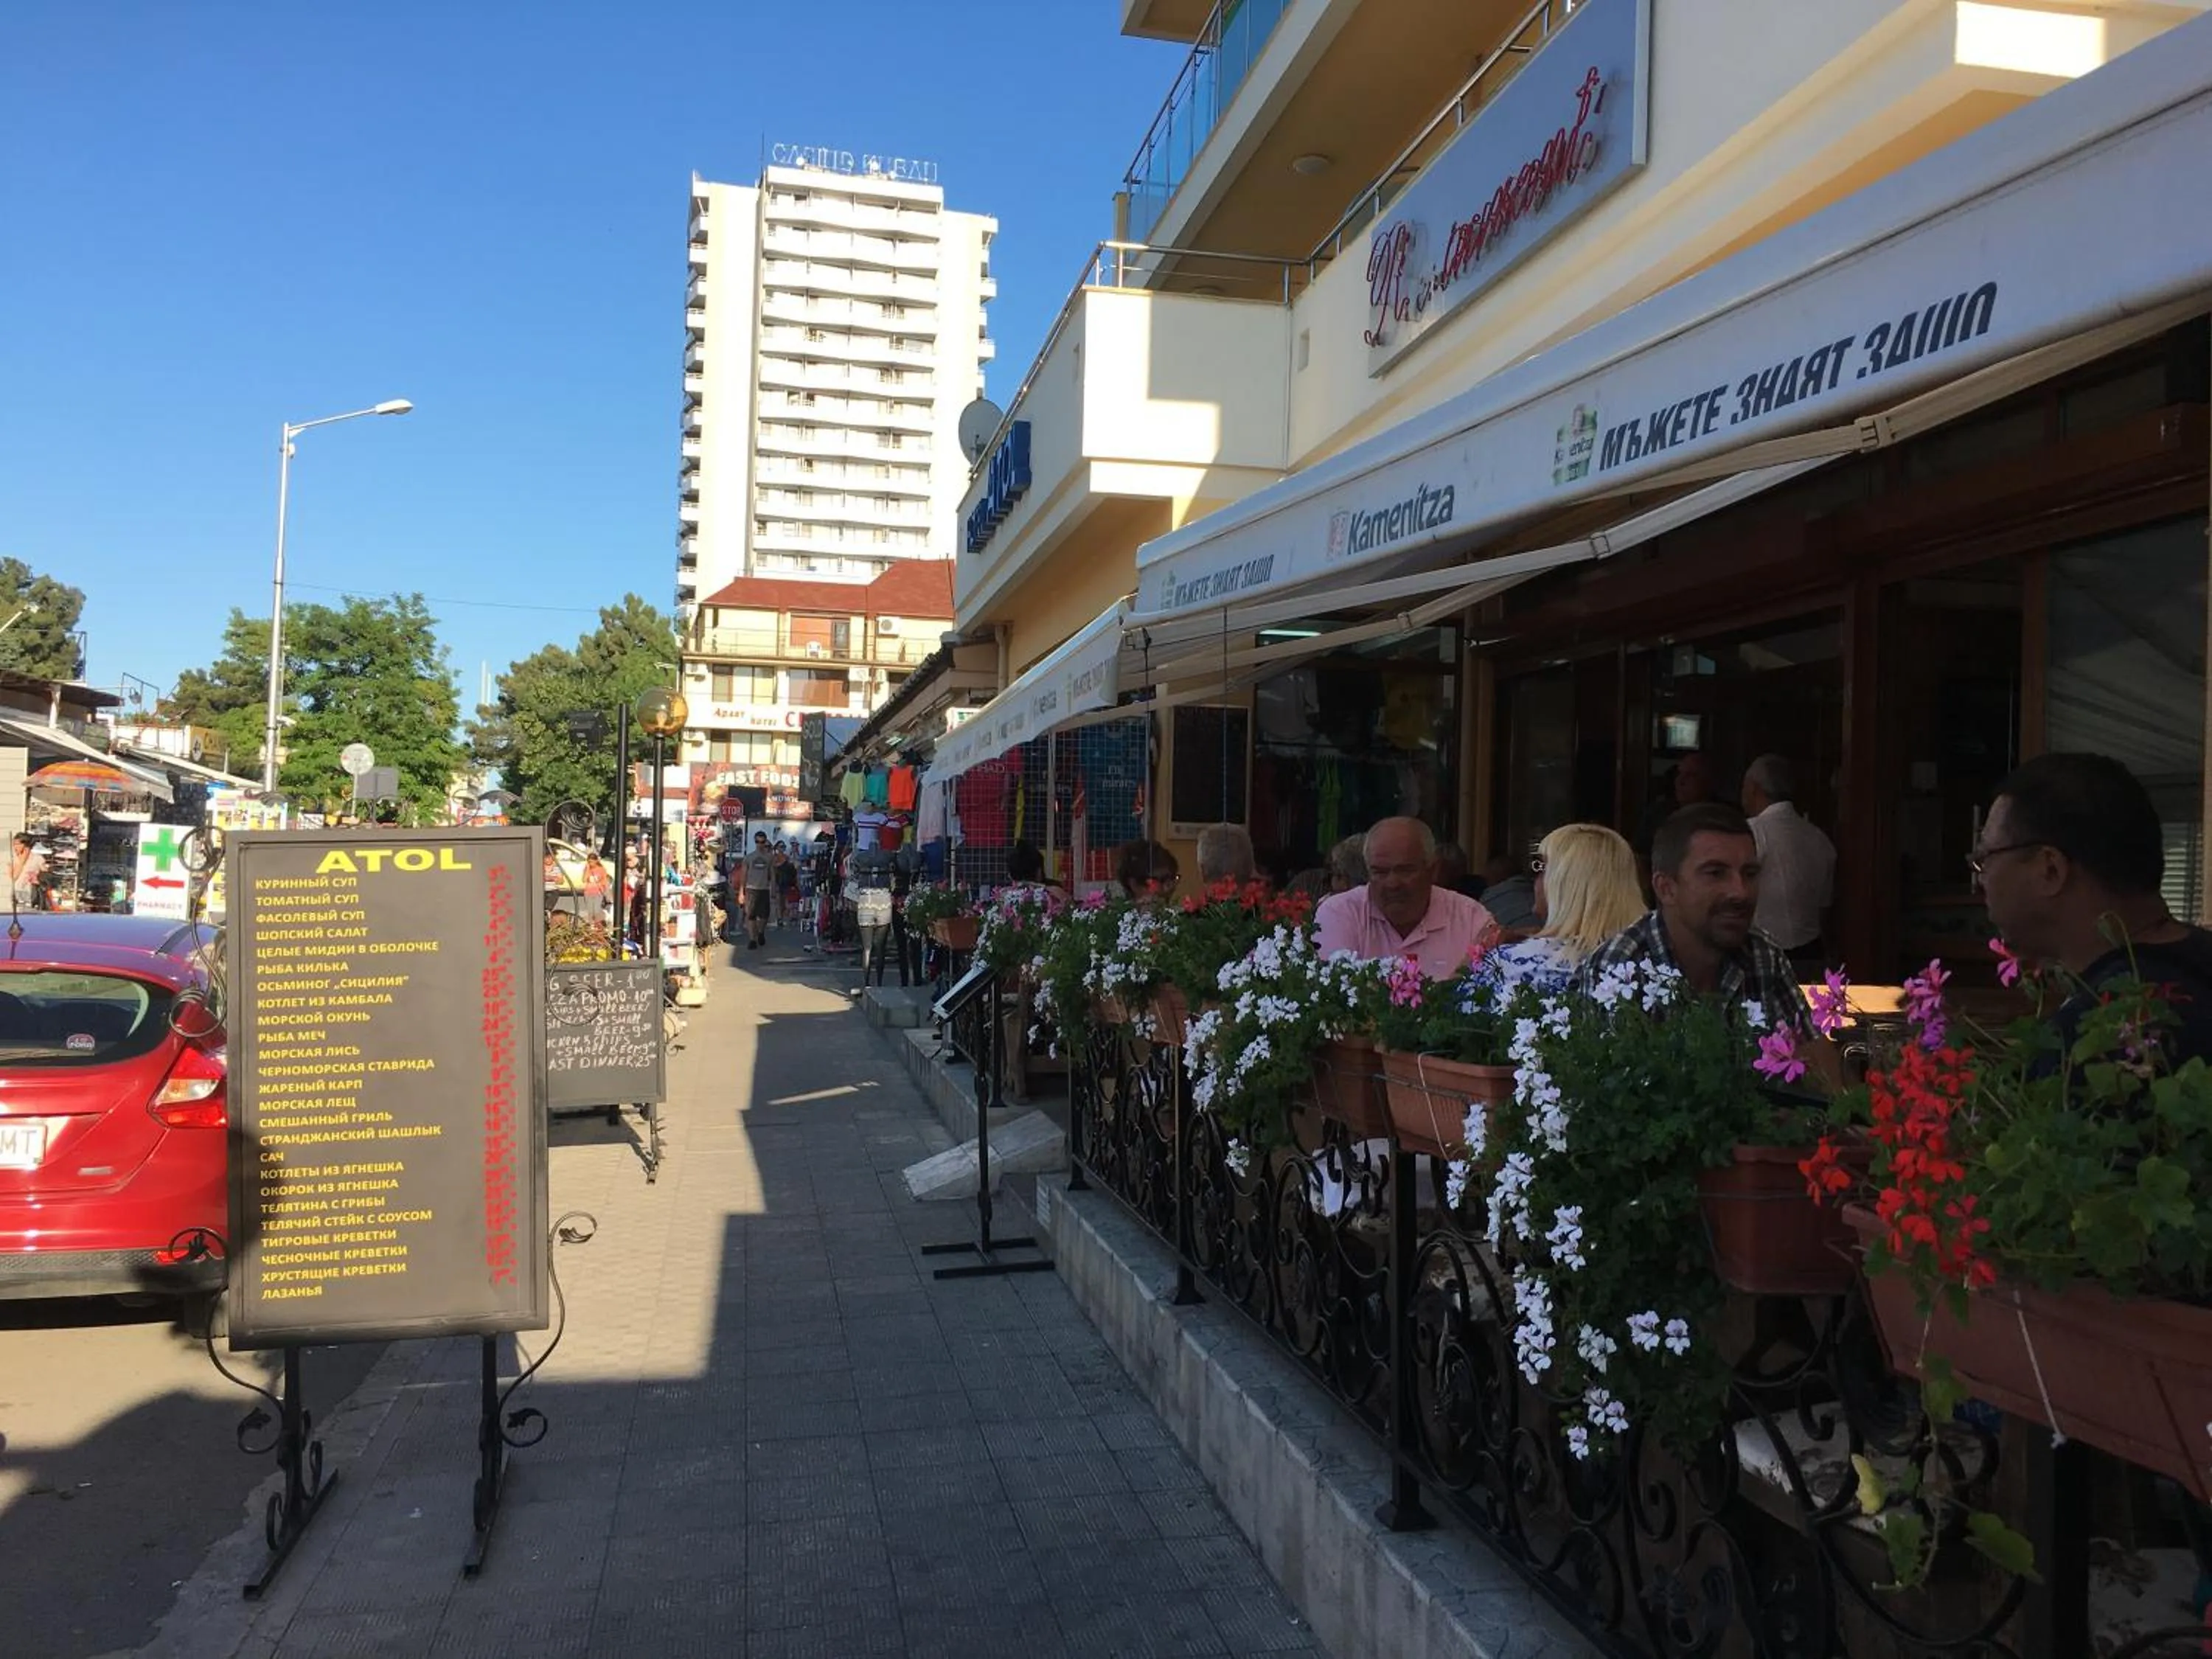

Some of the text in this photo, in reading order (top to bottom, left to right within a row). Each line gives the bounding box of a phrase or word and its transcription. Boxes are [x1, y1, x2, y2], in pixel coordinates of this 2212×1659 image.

[1599, 383, 1730, 472] МЪЖЕТЕ
[1730, 335, 1857, 426] ЗНАЯТ
[1346, 481, 1455, 556] Kamenitza
[716, 769, 757, 787] FAST
[722, 805, 743, 814] STOP
[316, 847, 472, 874] ATOL
[255, 875, 358, 890] КУРИННЫЙ СУП
[255, 893, 360, 907] ТОМАТНЫЙ СУП
[255, 909, 366, 924] ФАСОЛЕВЫЙ СУП
[255, 927, 369, 942] ШОПСКИЙ САЛАТ
[256, 941, 439, 959] ЦЕЛЫЕ МИДИИ В ОБОЛОЧКЕ
[256, 961, 349, 975] РЫБА КИЛЬКА
[257, 979, 331, 992] ОСЬМИНОГ
[257, 993, 392, 1010] КОТЛЕТ ИЗ КАМБАЛА
[257, 1012, 370, 1026] МОРСКОЙ ОКУНЬ
[258, 1029, 327, 1044] РЫБА МЕЧ
[259, 1046, 323, 1061] МОРСКАЯ
[259, 1059, 434, 1078] ЧЕРНОМОРСКАЯ СТАВРИДА
[260, 1079, 364, 1095] ЖАРЕНЫЙ КАРП
[260, 1096, 358, 1113] МОРСКАЯ ЛЕЩ
[260, 1111, 392, 1129] СМЕШАННЫЙ ГРИЛЬ
[260, 1126, 443, 1146] СТРАНДЖАНСКИЙ ШАШЛЫК
[260, 1152, 285, 1163] САЧ
[261, 1161, 405, 1180] КОТЛЕТЫ ИЗ ЯГНЕШКА
[261, 1179, 400, 1197] ОКОРОК ИЗ ЯГНЕШКА
[261, 1196, 386, 1214] ТЕЛЯТИНА С ГРИБЫ
[261, 1209, 434, 1231] ТЕЛЯЧИЙ СТЕЙК С СОУСОМ
[262, 1228, 398, 1249] ТИГРОВЫЕ КРЕВЕТКИ
[262, 1245, 408, 1266] ЧЕСНОЧНЫЕ КРЕВЕТКИ
[262, 1262, 408, 1284] ХРУСТЯЩИЕ КРЕВЕТКИ
[262, 1284, 323, 1300] ЛАЗАНЬЯ
